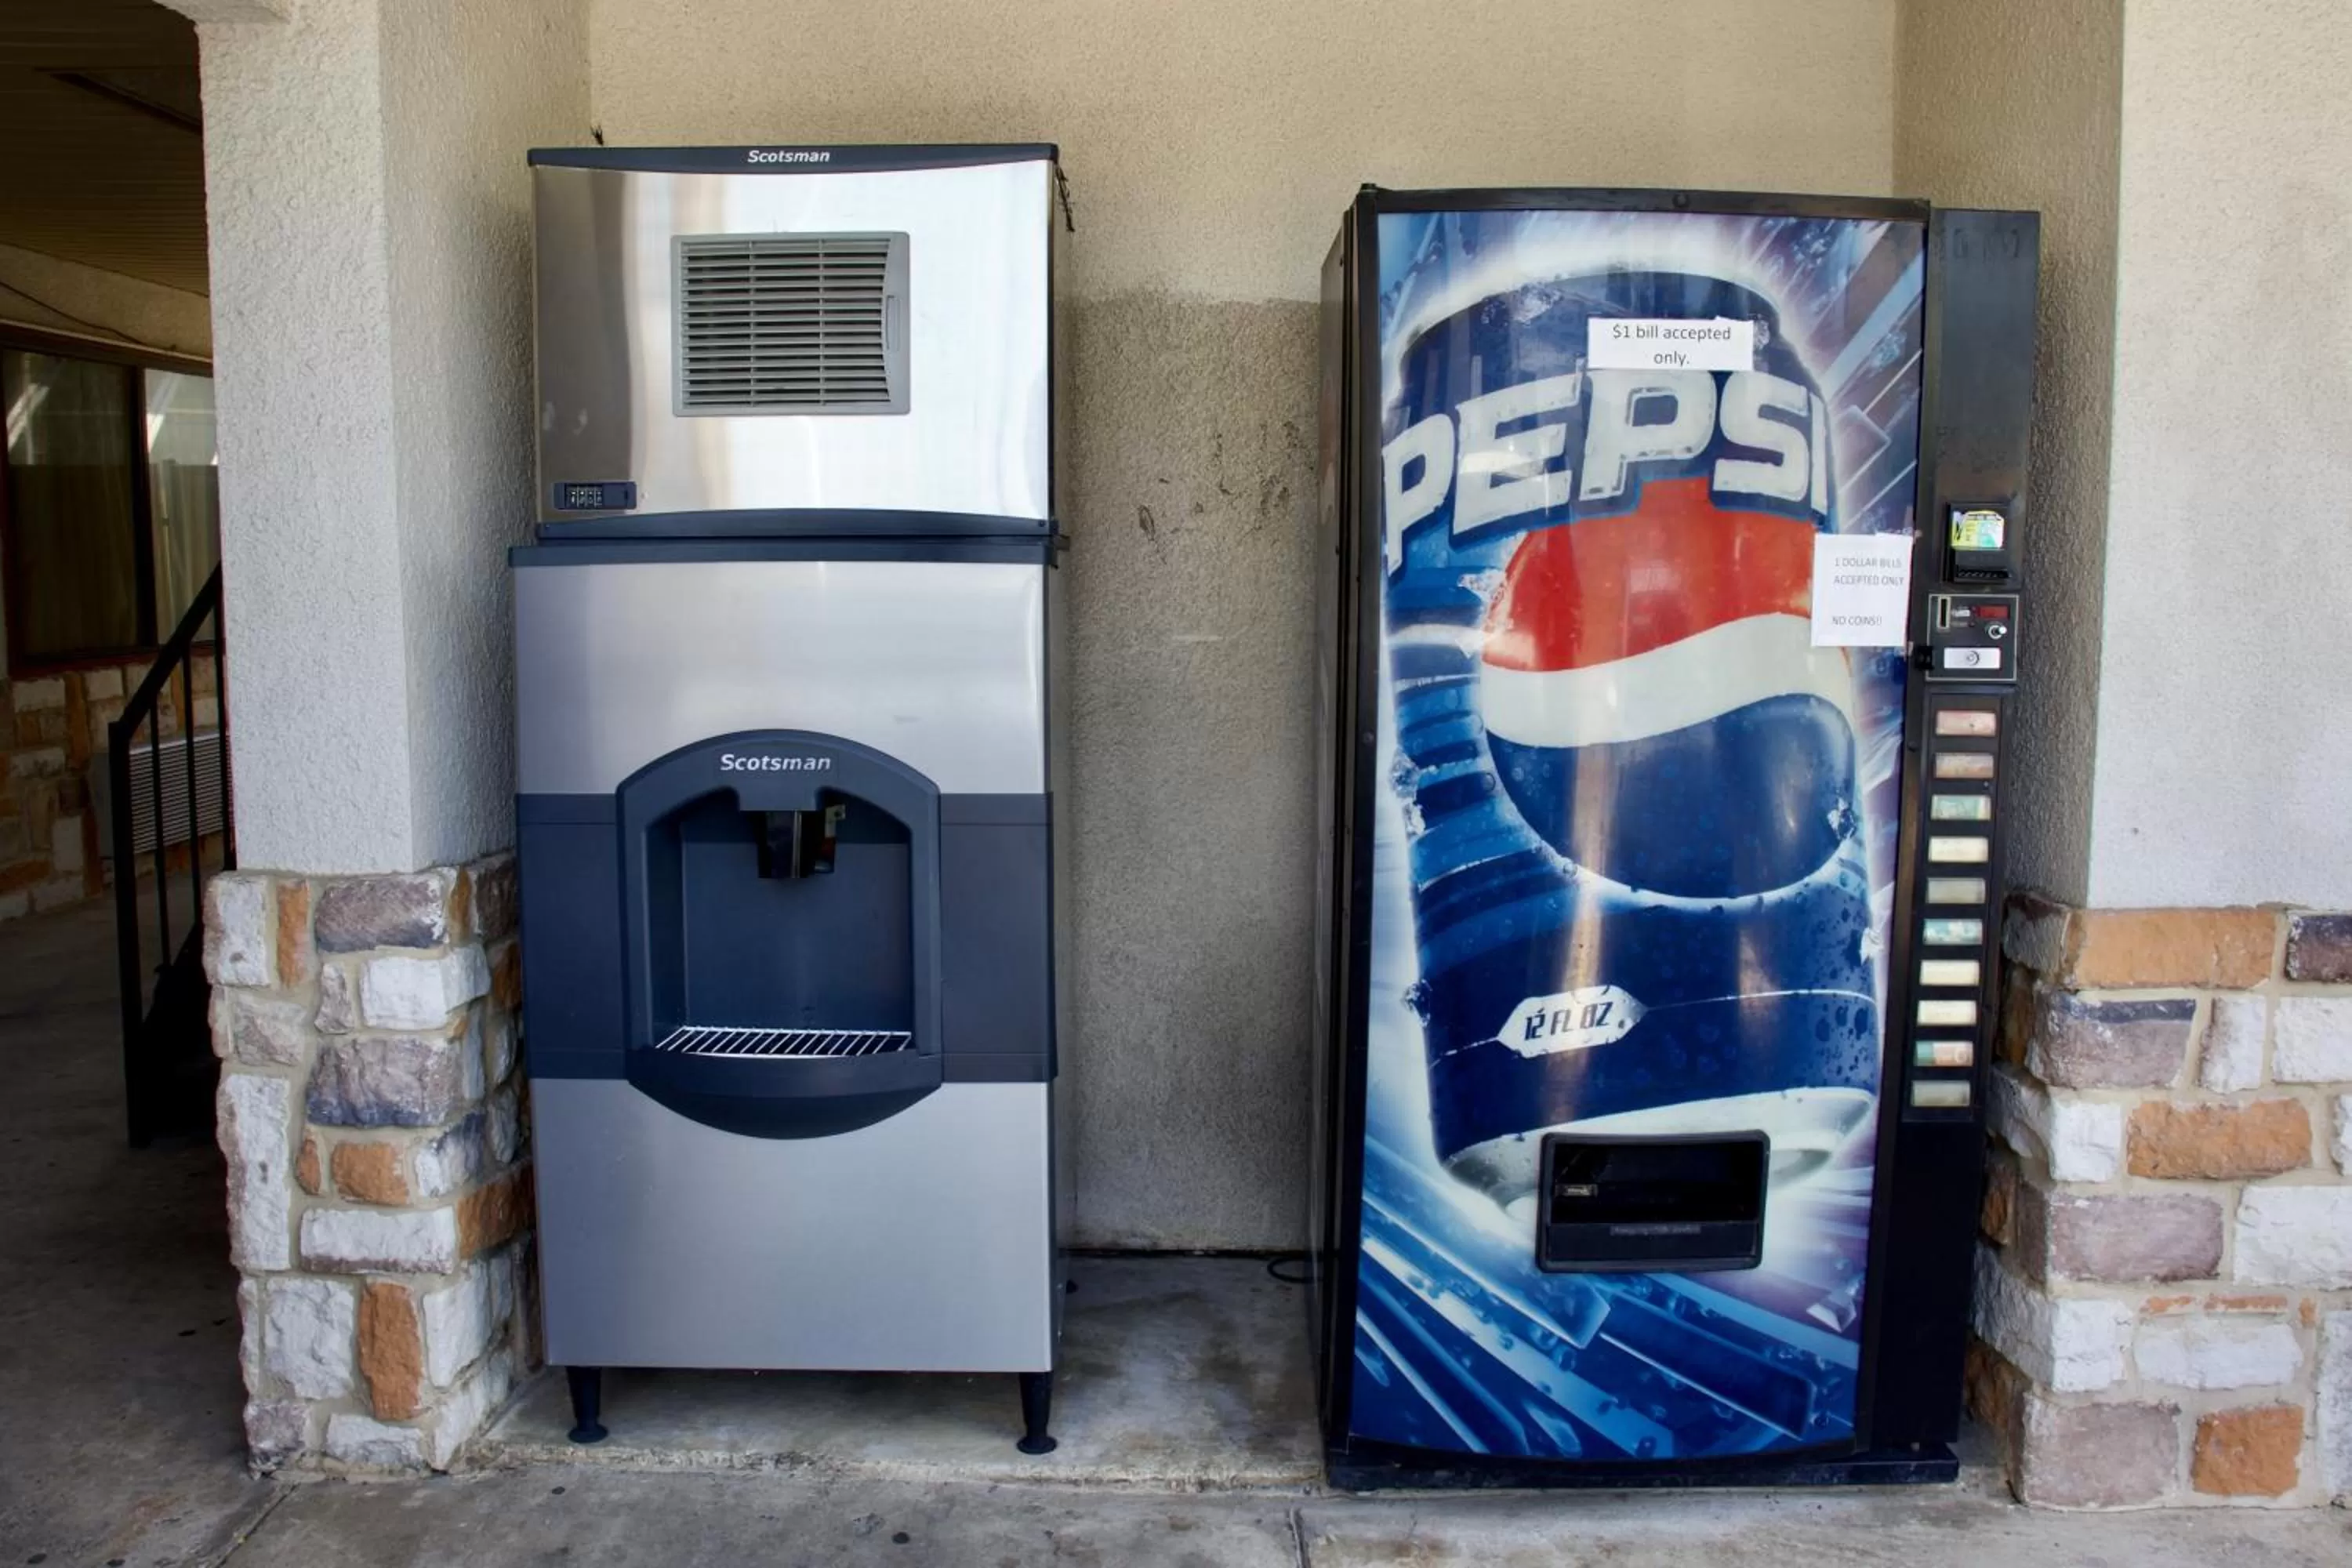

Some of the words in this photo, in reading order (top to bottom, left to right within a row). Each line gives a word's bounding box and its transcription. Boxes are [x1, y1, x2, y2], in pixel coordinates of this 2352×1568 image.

[747, 150, 830, 163] Scotsman
[1613, 324, 1630, 339] $1
[1636, 325, 1659, 339] bill
[1663, 326, 1731, 343] accepted
[1653, 351, 1690, 366] only.
[1842, 557, 1878, 568] DOLLAR
[1880, 557, 1902, 568] BILLS
[1833, 575, 1879, 586] ACCEPTED
[1882, 576, 1904, 586] ONLY
[1832, 615, 1846, 626] NO
[720, 753, 831, 771] Scotsman
[1523, 1011, 1546, 1041] 12
[1550, 1008, 1574, 1036] FL
[1580, 1001, 1613, 1029] OZ
